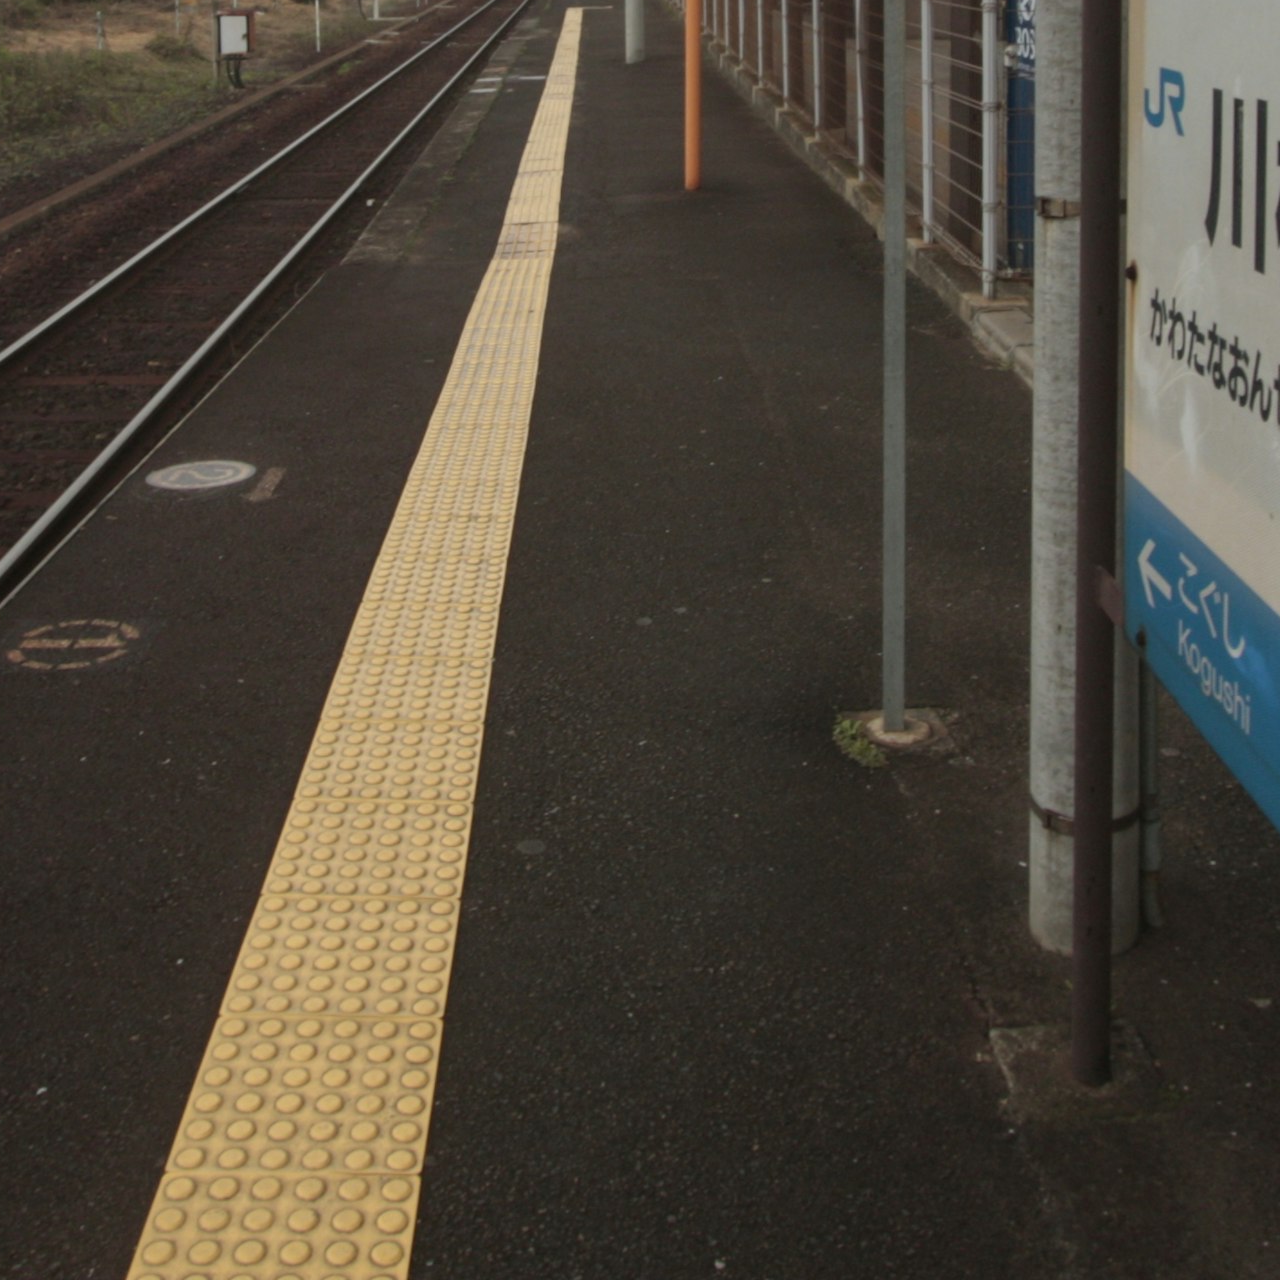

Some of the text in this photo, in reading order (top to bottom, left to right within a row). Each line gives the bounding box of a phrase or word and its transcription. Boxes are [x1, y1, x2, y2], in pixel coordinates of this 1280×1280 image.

[1144, 67, 1186, 137] JR
[1176, 553, 1246, 659] こぐし
[1176, 619, 1252, 735] Kogushi
